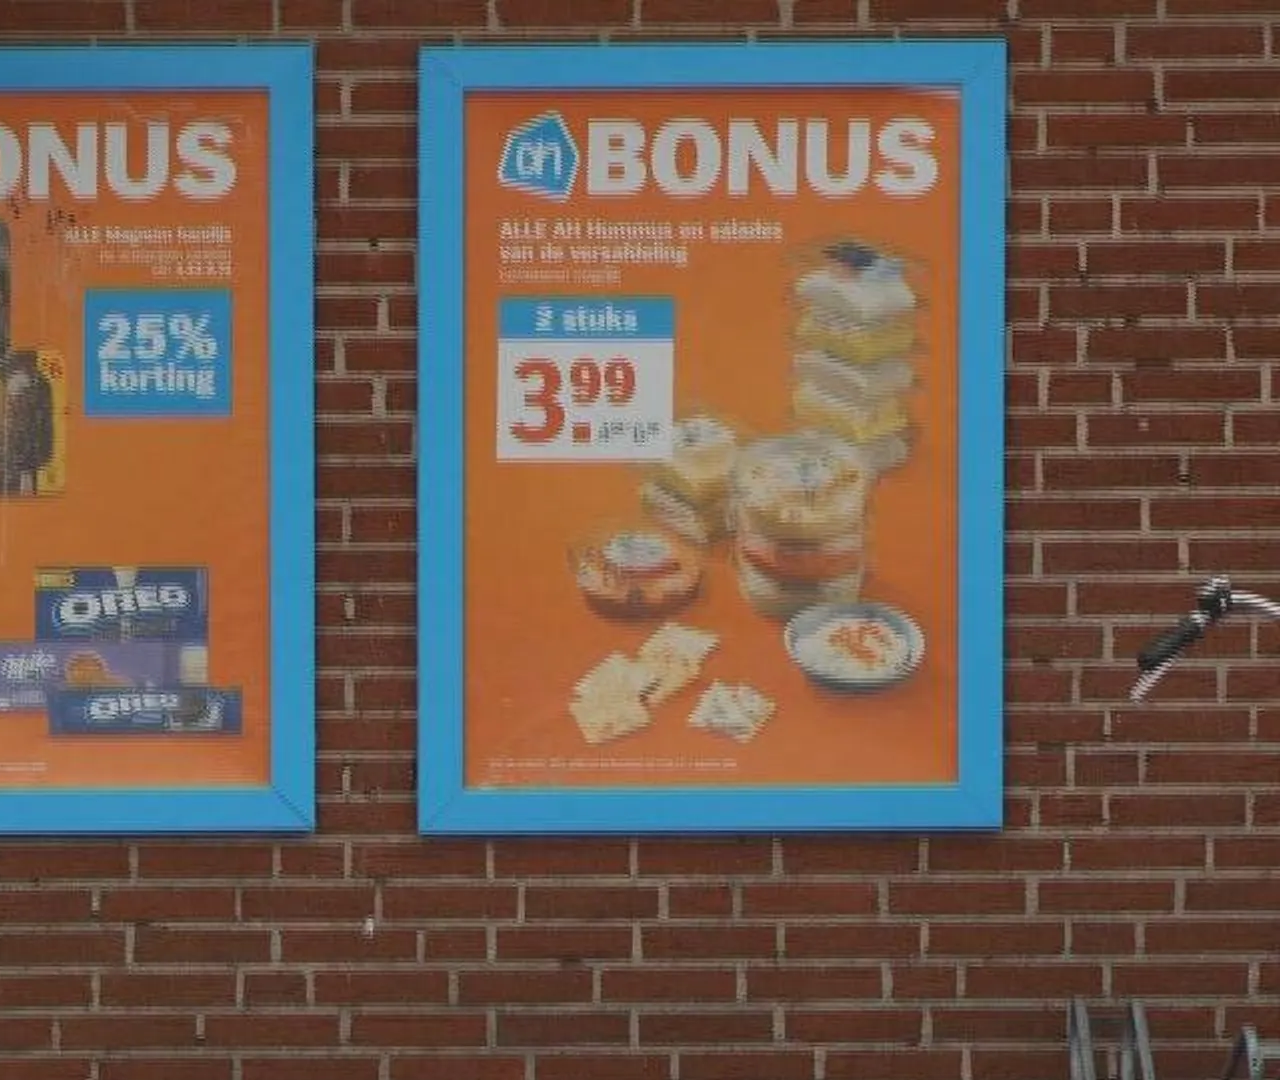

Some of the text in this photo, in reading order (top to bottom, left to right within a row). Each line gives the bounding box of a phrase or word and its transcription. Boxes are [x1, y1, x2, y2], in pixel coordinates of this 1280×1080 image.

[586, 116, 941, 199] BONUS
[499, 221, 547, 240] ALLE
[98, 313, 218, 363] 25%
[535, 304, 638, 333] 2 stuks
[99, 363, 217, 399] korting
[510, 356, 637, 445] 3.99
